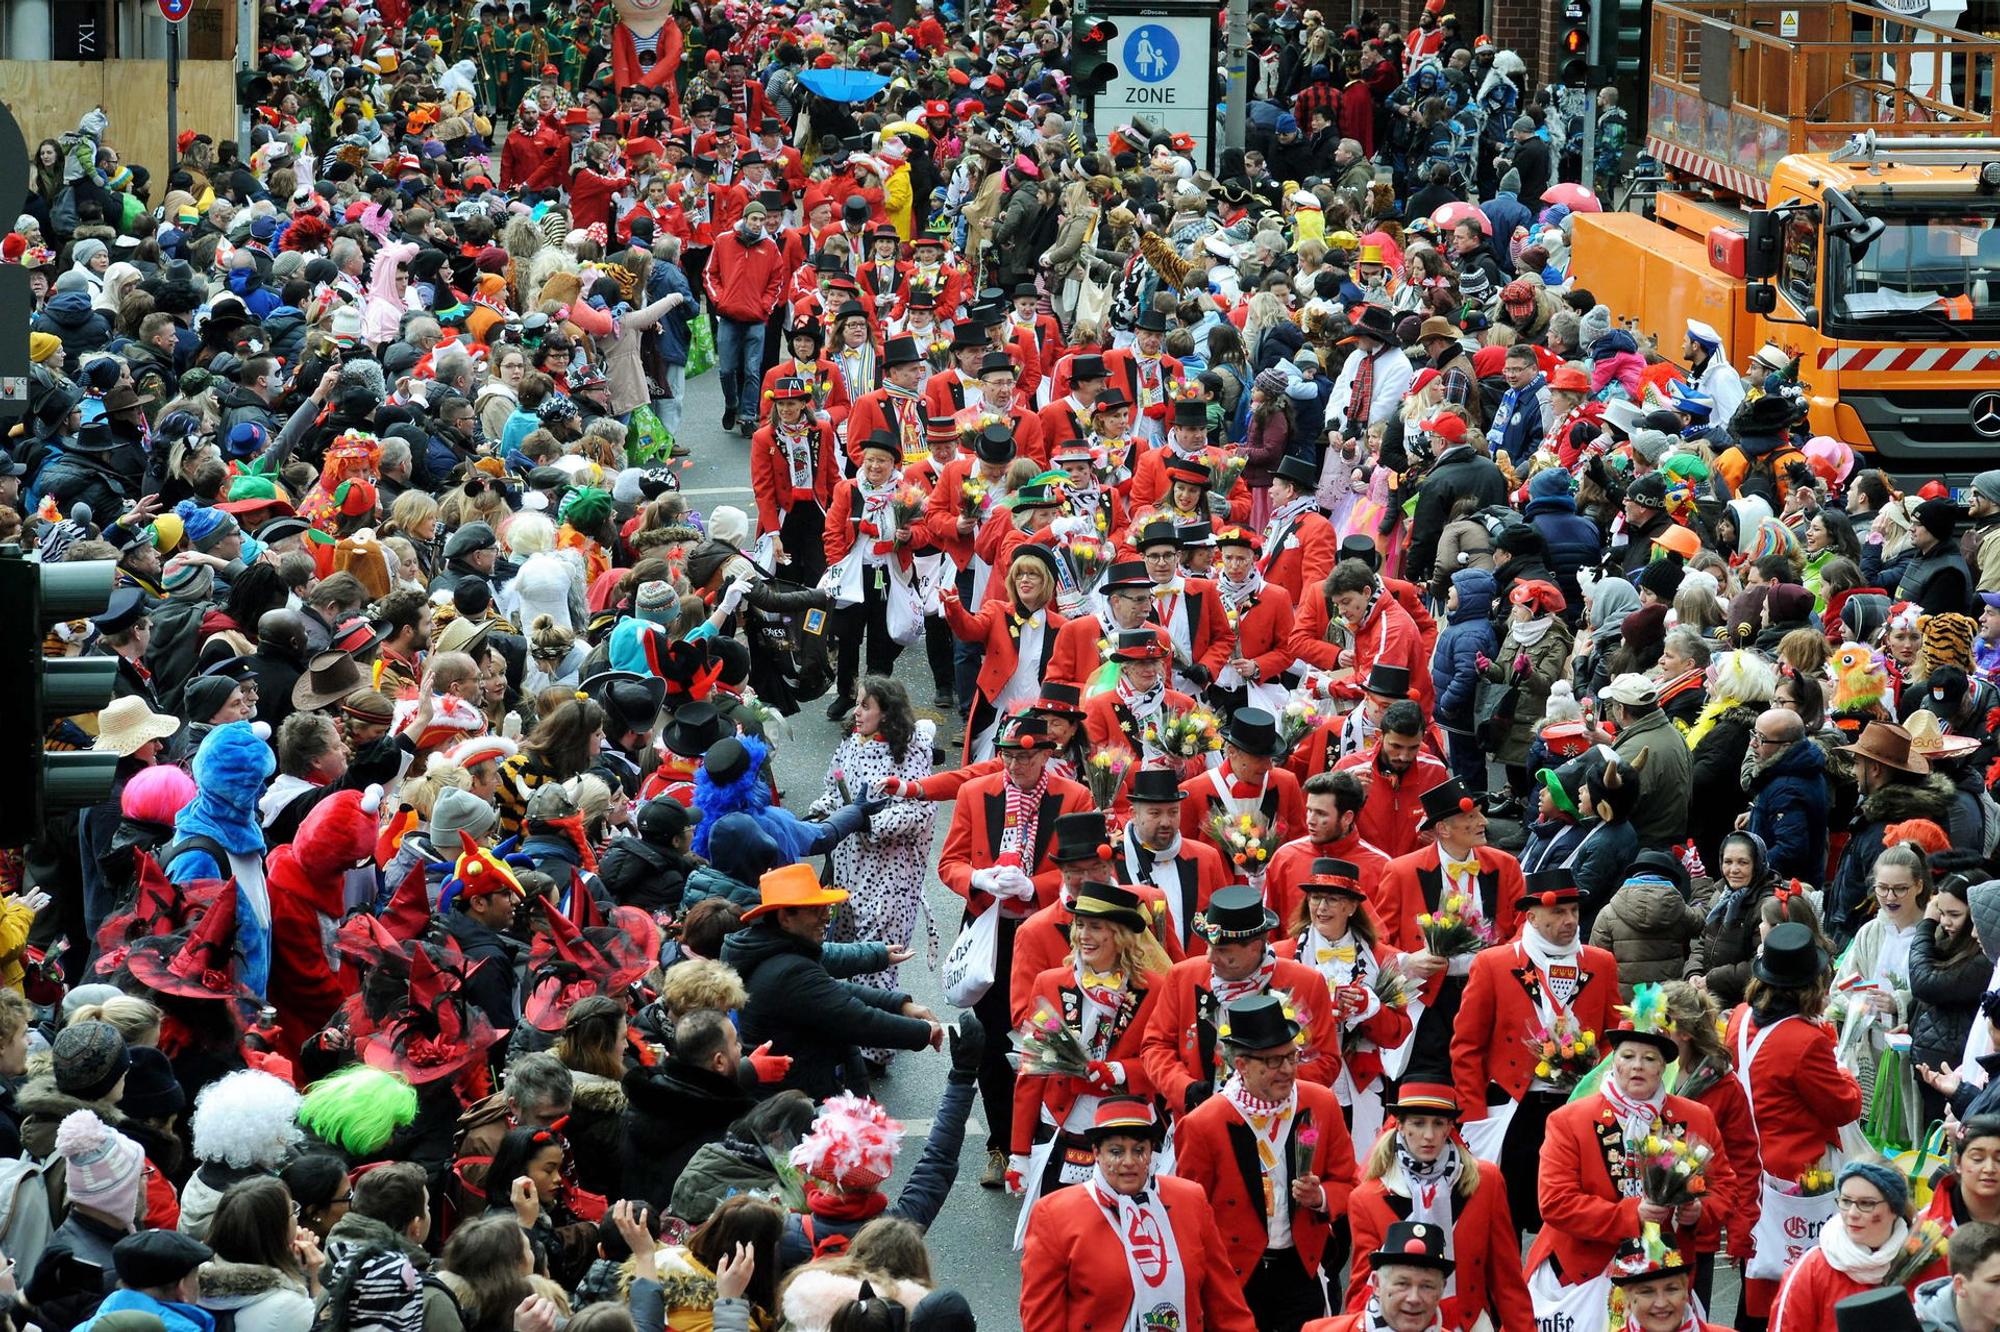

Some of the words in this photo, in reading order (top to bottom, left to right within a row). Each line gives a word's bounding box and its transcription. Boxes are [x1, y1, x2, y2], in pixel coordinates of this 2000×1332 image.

[78, 18, 95, 54] 7XL
[1125, 87, 1176, 104] ZONE
[1534, 1311, 1575, 1332] roße
